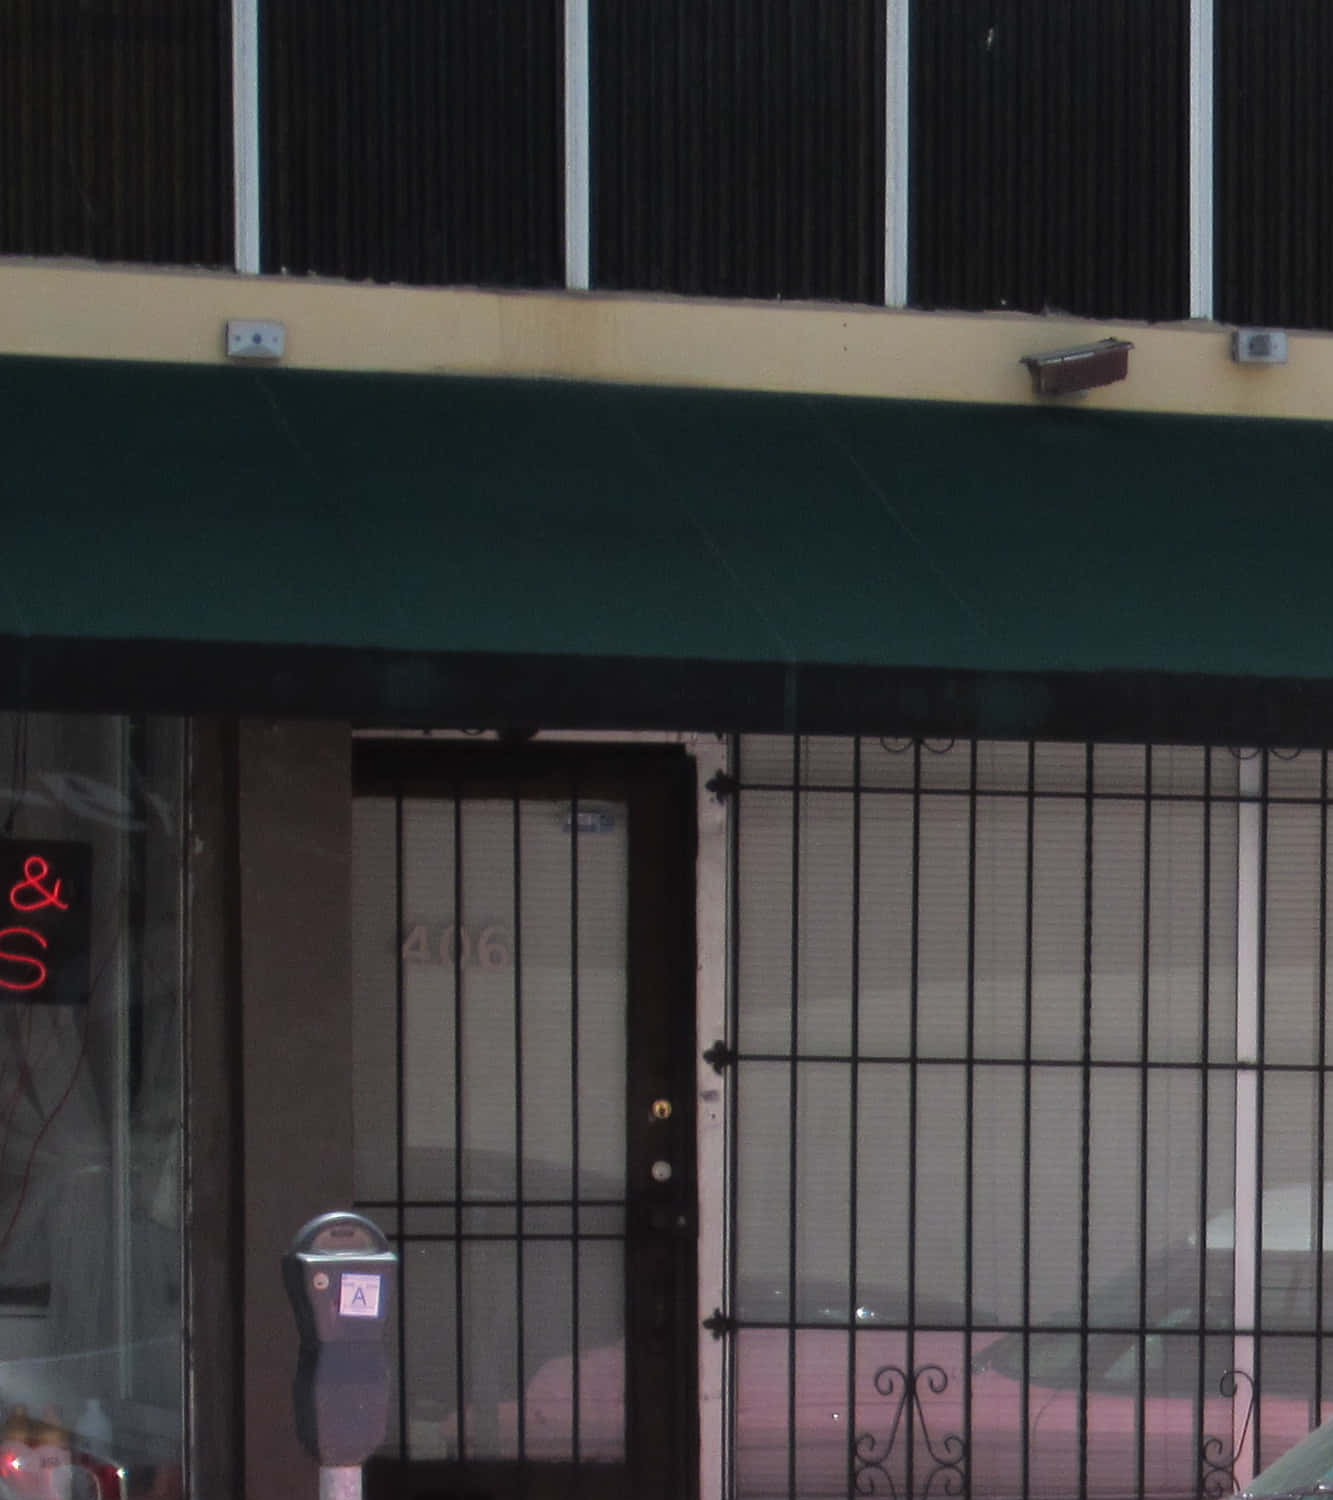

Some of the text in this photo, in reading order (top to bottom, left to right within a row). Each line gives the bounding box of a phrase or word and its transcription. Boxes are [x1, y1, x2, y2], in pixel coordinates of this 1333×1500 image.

[9, 855, 69, 911] &
[402, 926, 511, 970] 406
[352, 1287, 367, 1307] A
